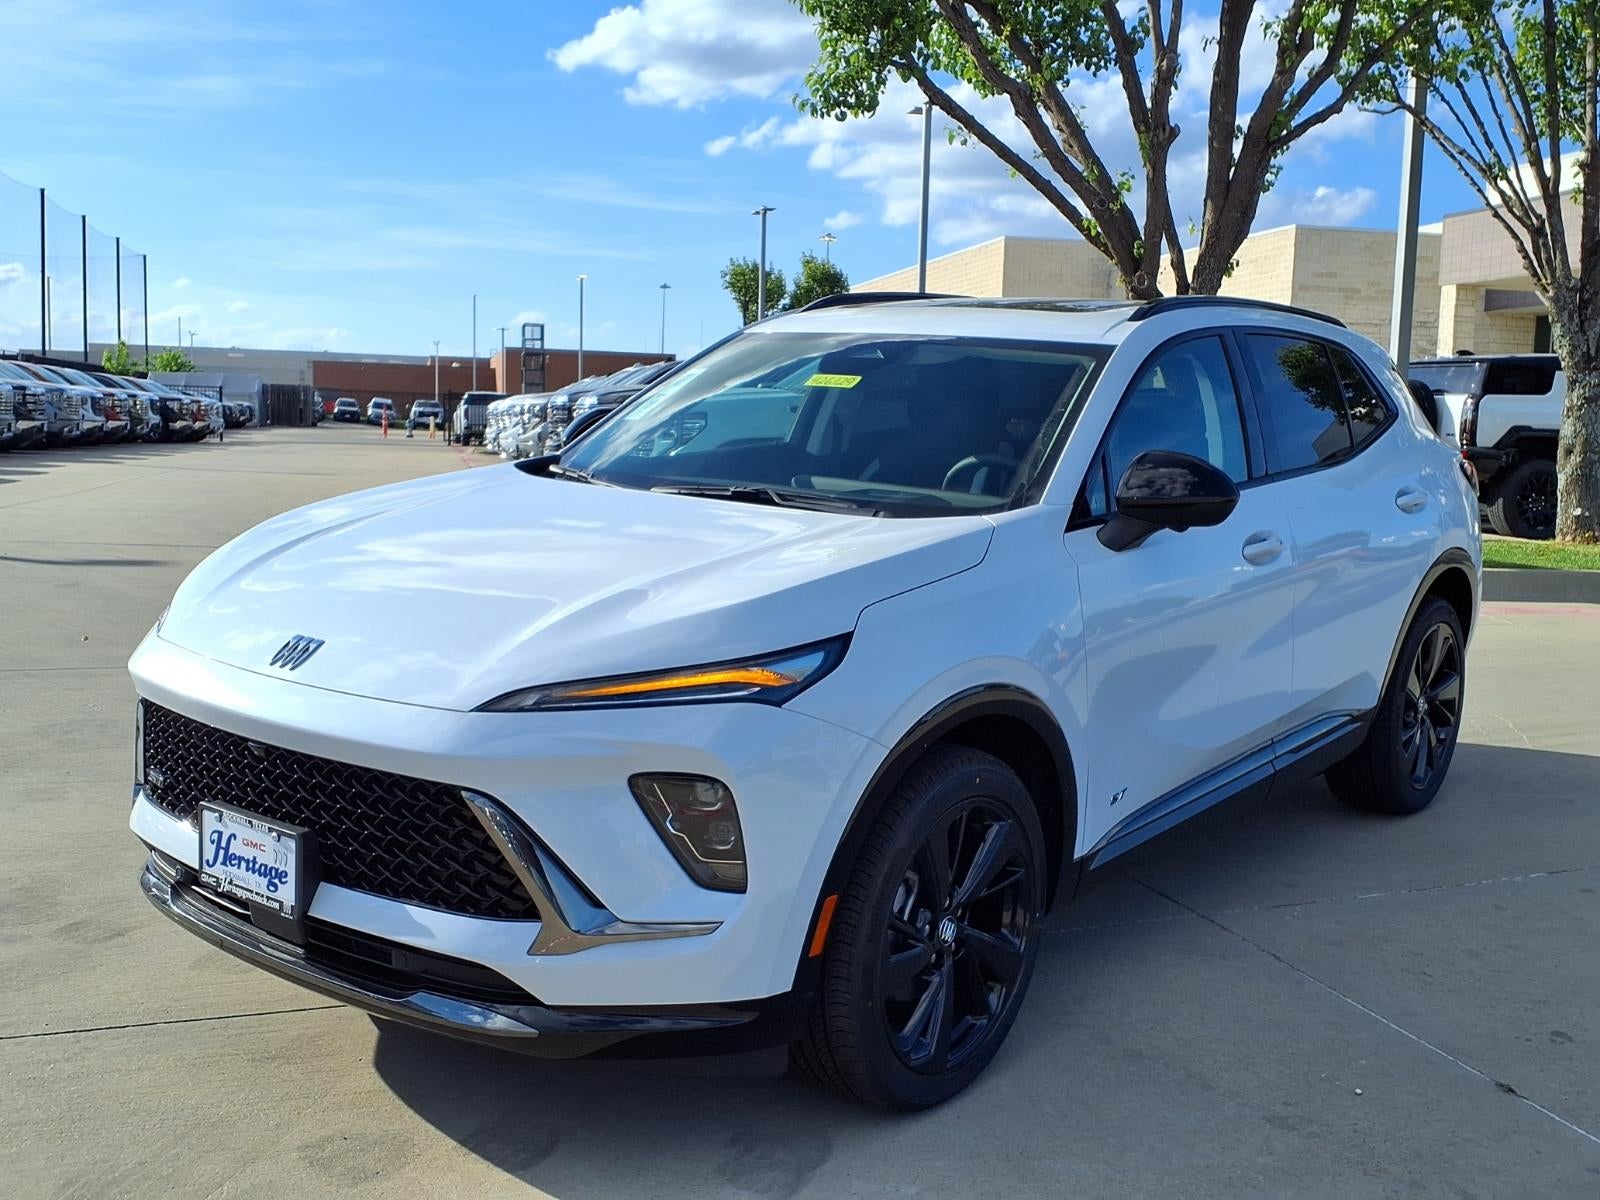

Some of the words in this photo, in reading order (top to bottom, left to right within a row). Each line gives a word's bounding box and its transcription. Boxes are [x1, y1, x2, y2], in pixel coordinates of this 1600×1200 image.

[242, 837, 266, 852] GMC
[205, 829, 289, 893] Heritage
[201, 873, 217, 886] GMC
